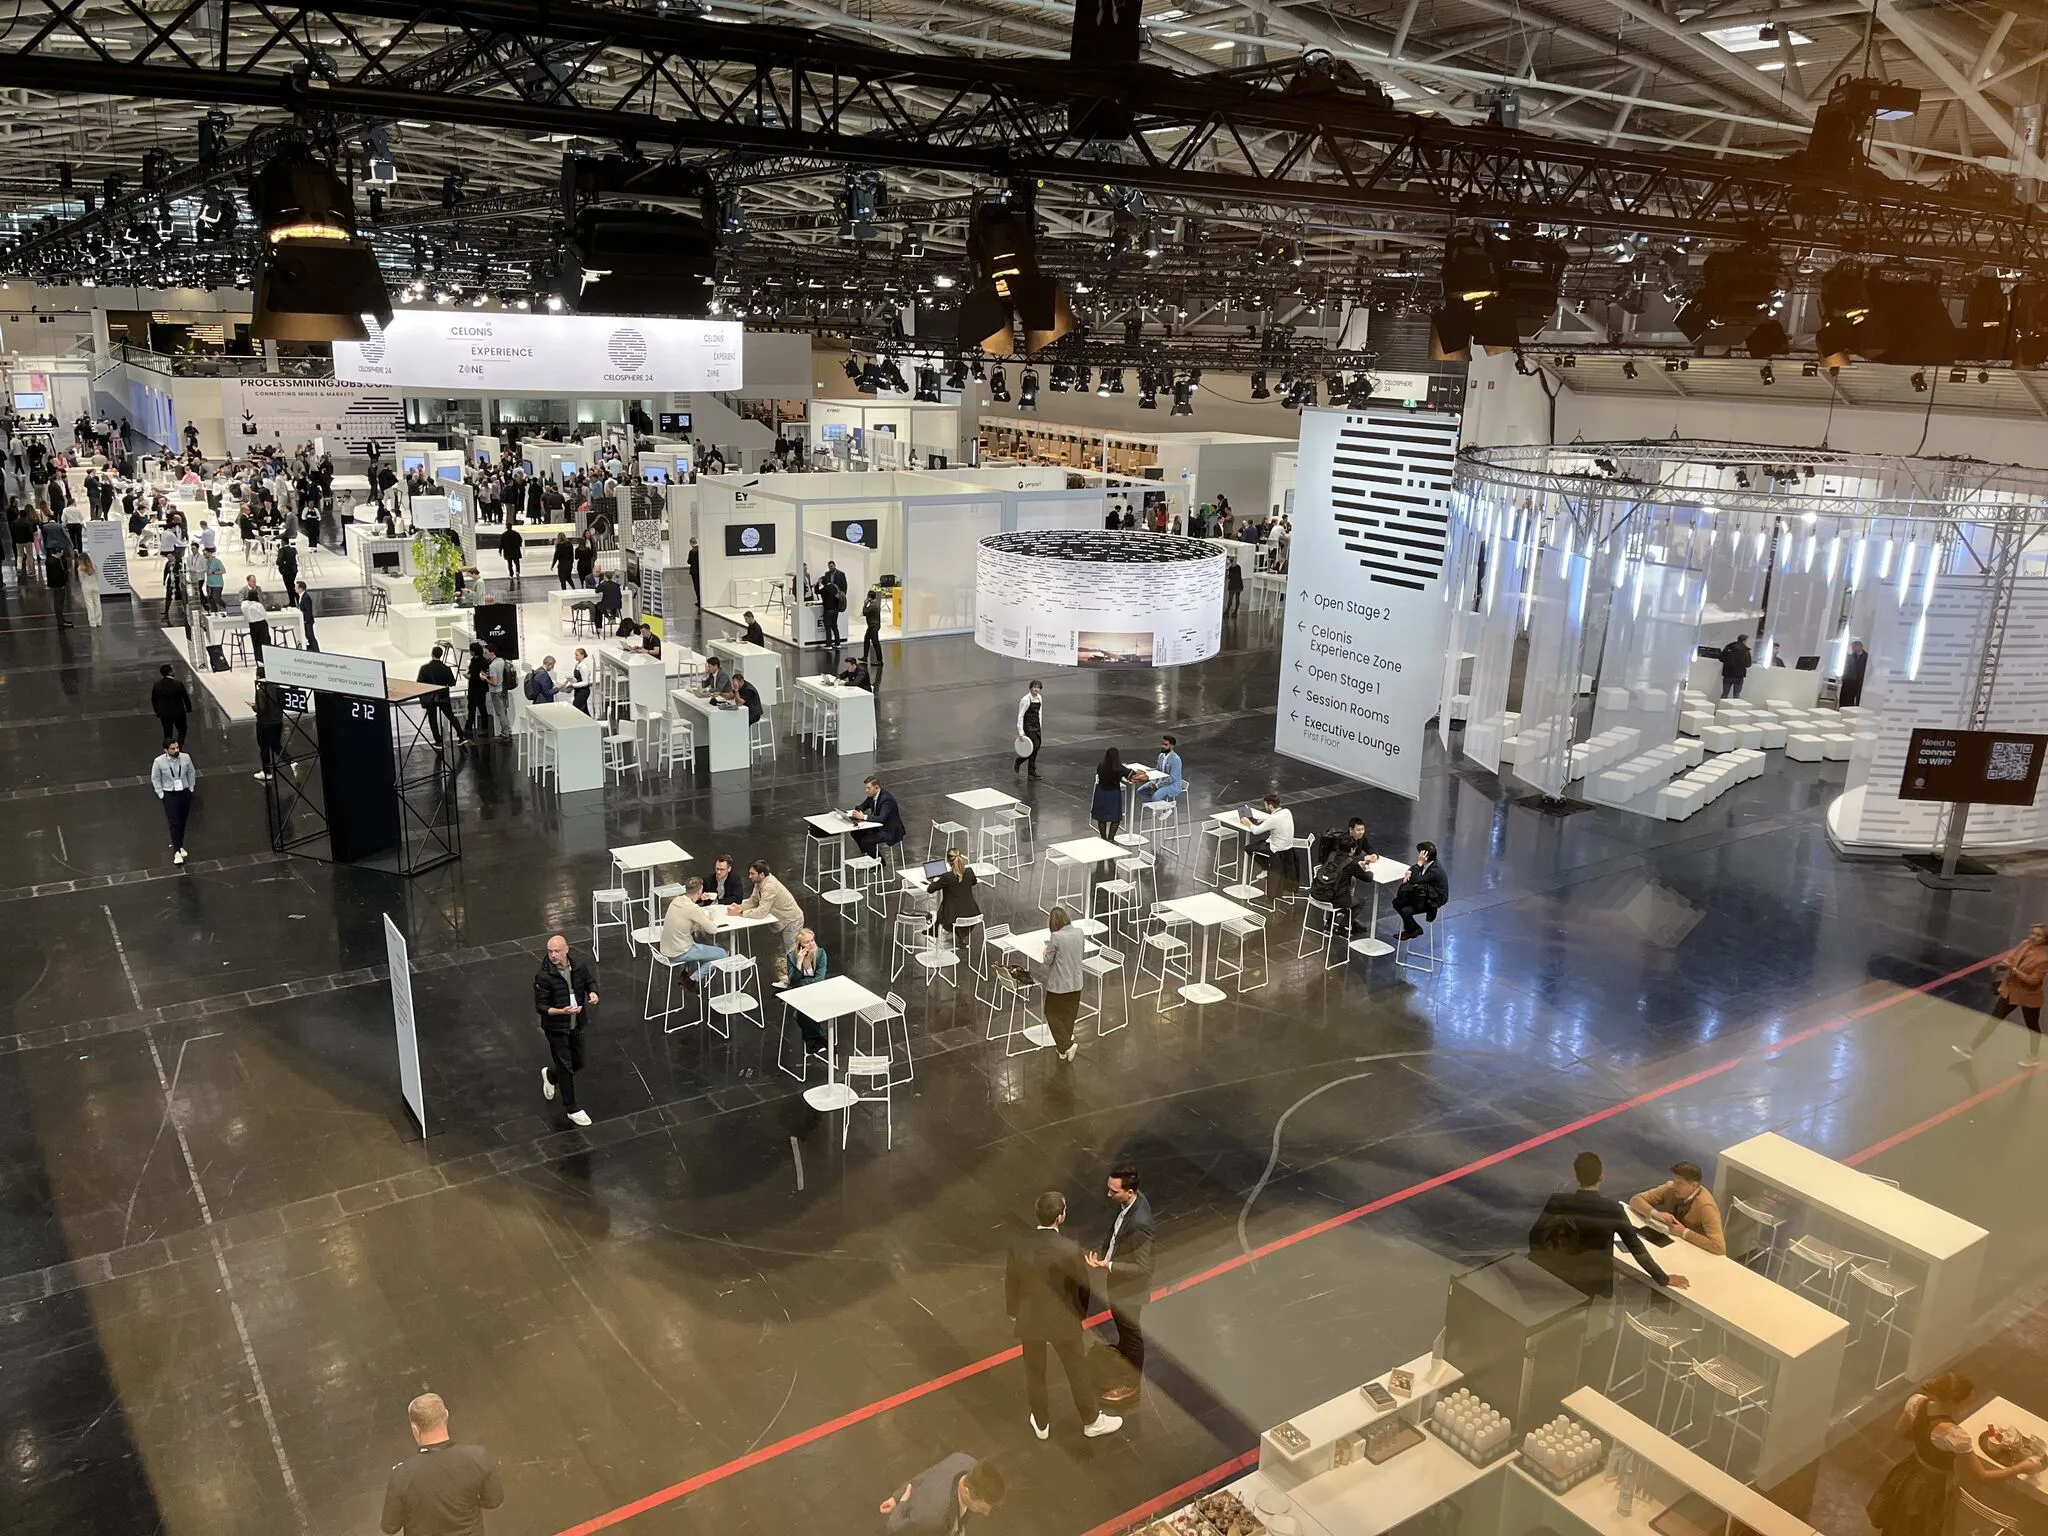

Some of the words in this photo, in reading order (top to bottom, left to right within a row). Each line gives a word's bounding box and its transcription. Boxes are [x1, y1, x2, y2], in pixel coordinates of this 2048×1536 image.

[451, 327, 493, 337] CELONIS
[471, 346, 534, 357] EXPERIENCE
[1384, 379, 1413, 387] CELOSPHERE
[735, 491, 748, 501] EY
[1314, 594, 1344, 611] Open
[1346, 600, 1380, 621] Stage
[1383, 607, 1391, 621] 2
[1311, 624, 1352, 645] Celonis
[1310, 639, 1370, 665] Experience
[1372, 655, 1402, 673] Zone
[1308, 664, 1338, 682] Open
[1340, 673, 1374, 694] Stage
[1376, 682, 1380, 695] 1
[284, 692, 306, 710] 322
[1306, 690, 1347, 712] Session
[1349, 702, 1390, 725] Rooms
[1303, 729, 1320, 742] First
[1321, 735, 1340, 749] Floor
[1304, 715, 1356, 741] Executive
[1358, 731, 1401, 757] Lounge
[1921, 738, 1946, 747] Need
[1918, 757, 1928, 765] to
[1920, 749, 1957, 757] connect
